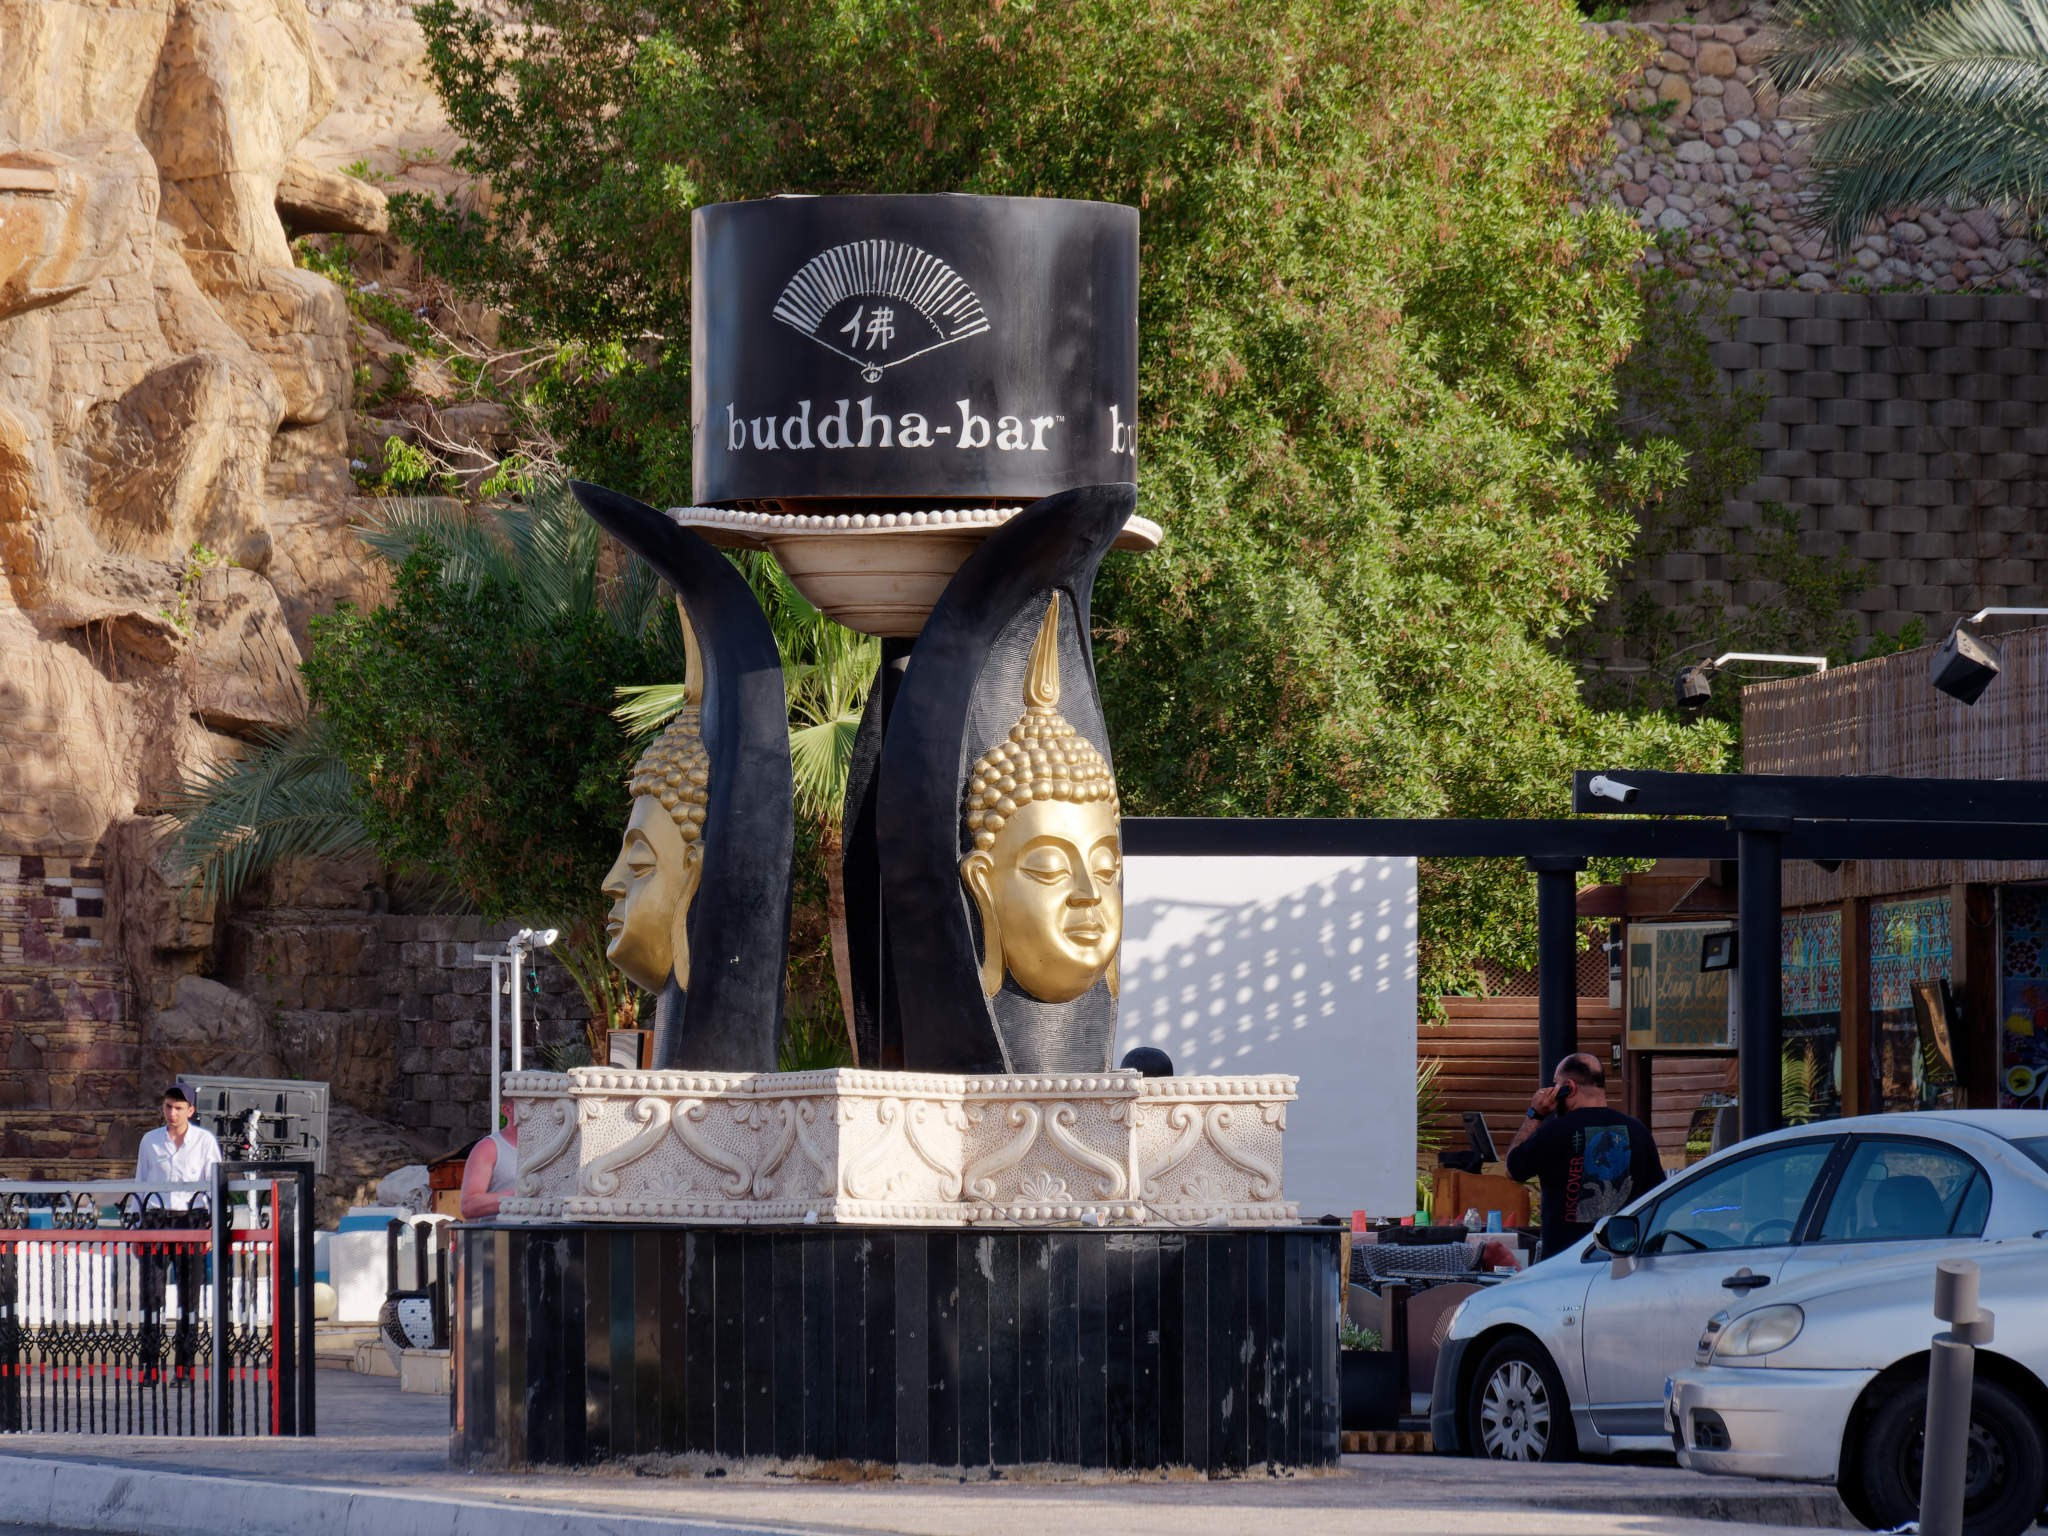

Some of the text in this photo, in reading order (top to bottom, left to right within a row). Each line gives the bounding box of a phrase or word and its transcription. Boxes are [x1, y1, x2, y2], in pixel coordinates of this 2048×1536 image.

[840, 305, 896, 351] 佛
[726, 397, 1055, 452] buddha-bar
[1565, 1156, 1584, 1223] DISCOVER
